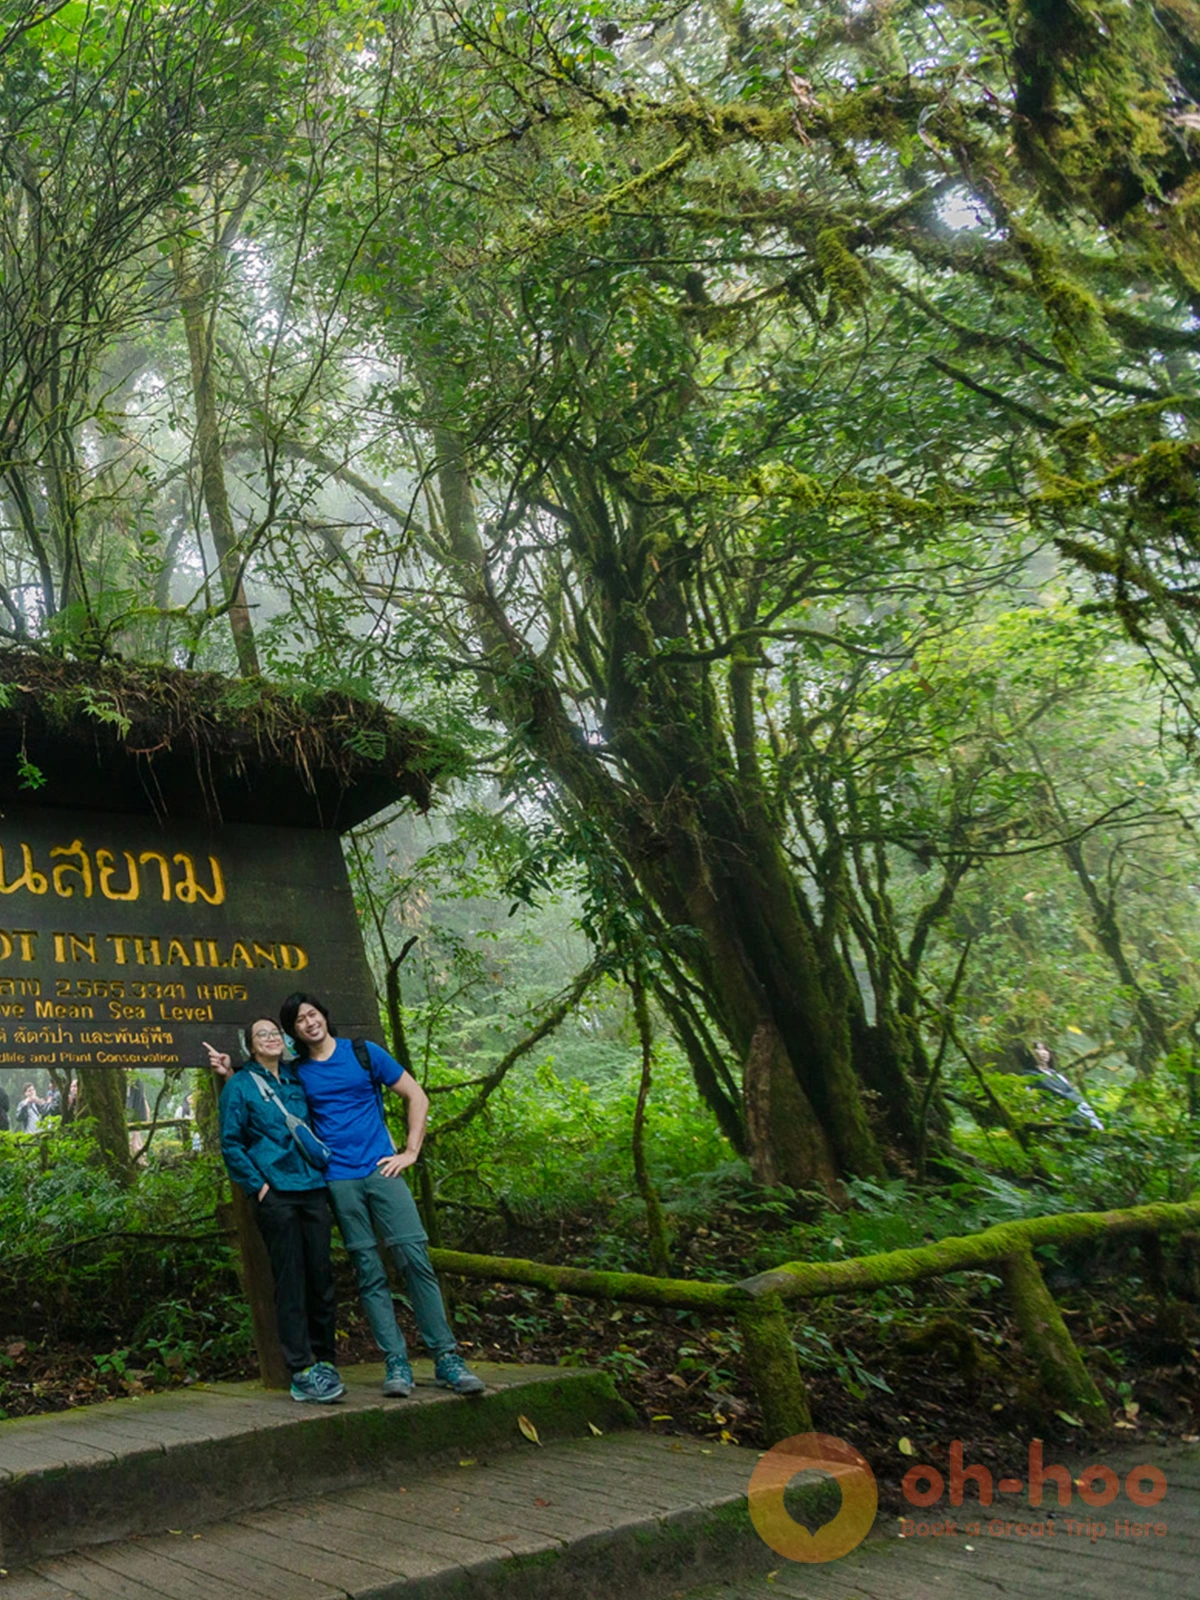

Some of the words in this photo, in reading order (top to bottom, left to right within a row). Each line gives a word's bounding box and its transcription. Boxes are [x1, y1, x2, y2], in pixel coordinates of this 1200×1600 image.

[52, 932, 98, 965] IN
[106, 934, 309, 971] THAILAND
[197, 983, 248, 1000] เมตร
[35, 1000, 94, 1019] Mean
[108, 1001, 146, 1020] Sea
[160, 1002, 213, 1021] Level
[30, 1053, 56, 1063] and
[60, 1052, 91, 1063] Plant
[96, 1051, 179, 1063] Conservation
